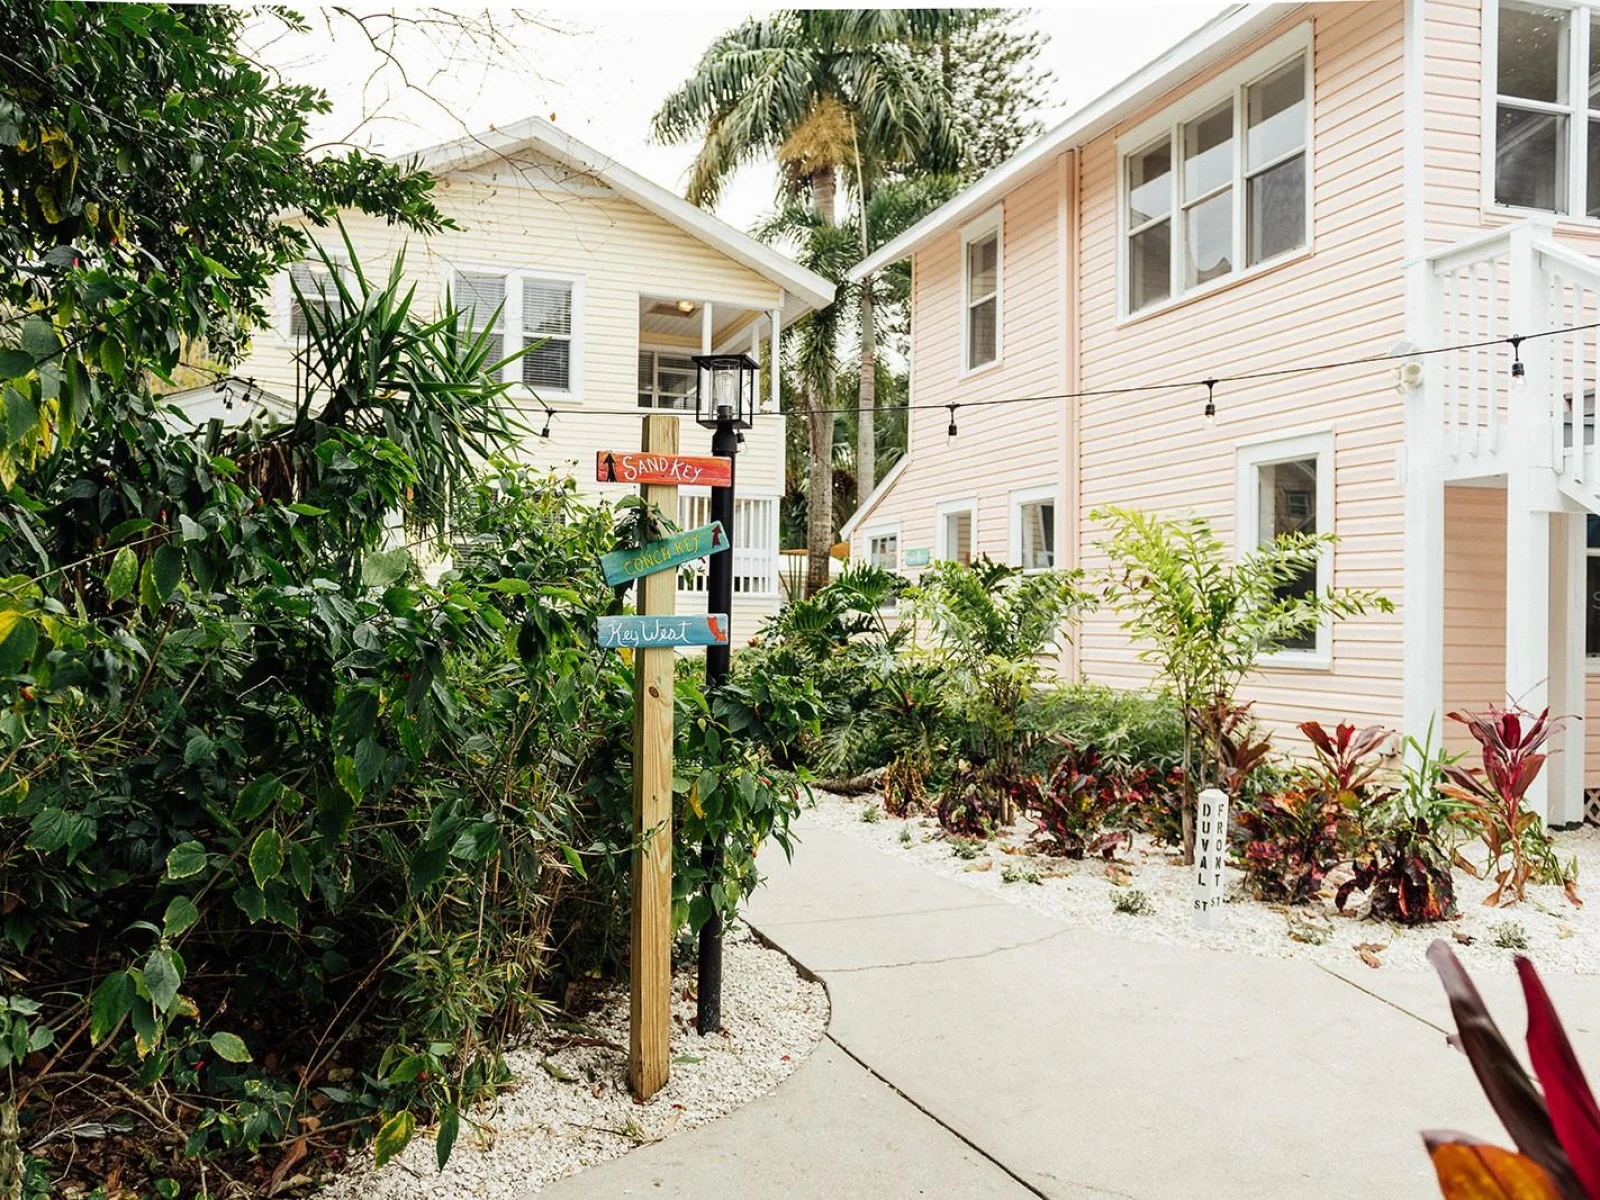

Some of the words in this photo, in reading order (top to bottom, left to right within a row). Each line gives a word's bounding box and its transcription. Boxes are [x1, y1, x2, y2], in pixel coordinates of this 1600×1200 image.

[622, 456, 669, 480] SAND
[670, 458, 703, 483] KEY
[622, 547, 672, 576] CONCH
[674, 534, 699, 555] KEY
[605, 622, 640, 647] Key
[640, 618, 692, 644] West
[1197, 803, 1212, 887] DUVAL
[1194, 899, 1208, 911] ST
